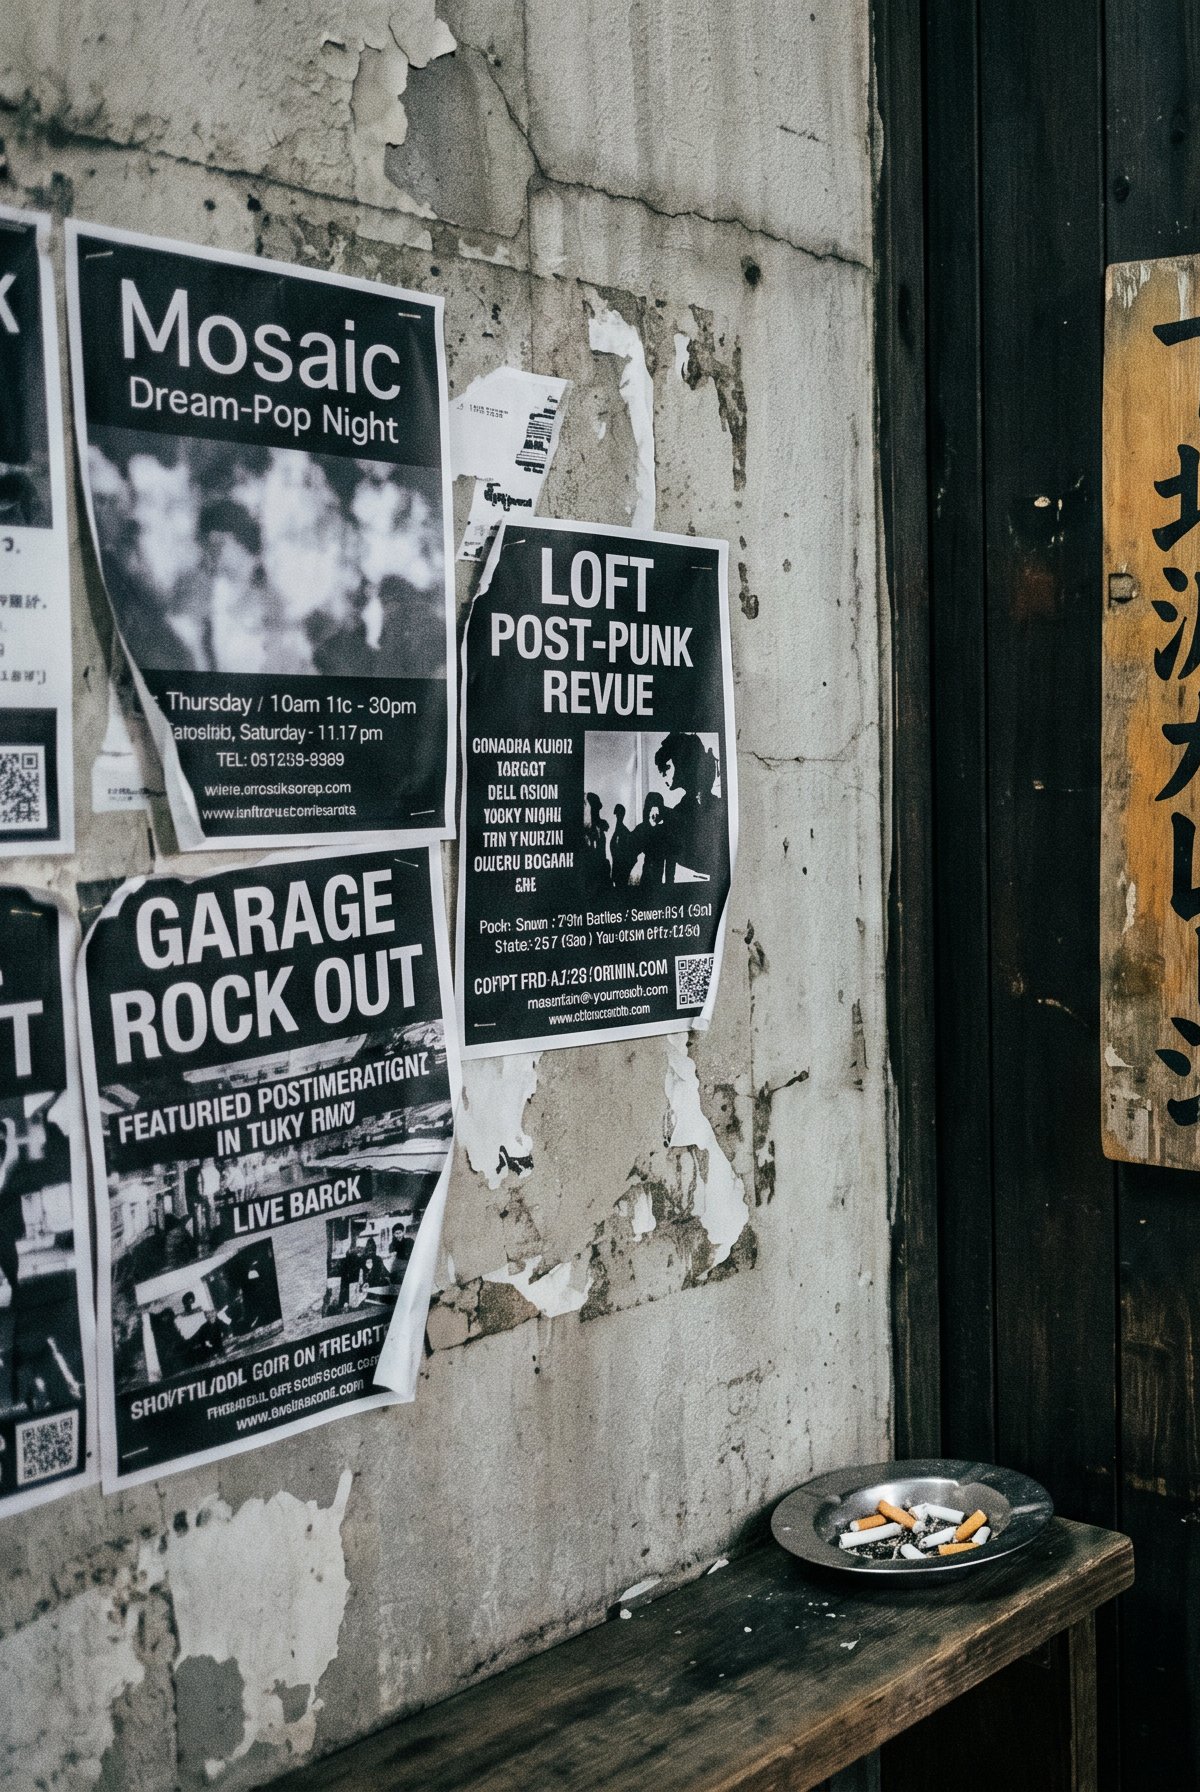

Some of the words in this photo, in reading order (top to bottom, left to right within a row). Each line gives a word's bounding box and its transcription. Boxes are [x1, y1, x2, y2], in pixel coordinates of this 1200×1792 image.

[120, 278, 401, 401] Mosaic
[130, 376, 312, 437] Dream-Pop
[323, 405, 399, 446] Night
[541, 547, 655, 613] LOFT
[491, 612, 694, 668] POST-PUNK
[166, 692, 252, 716] Thursday
[270, 694, 320, 713] 10am
[369, 697, 417, 717] 30pm
[543, 670, 654, 717] REVUE
[216, 752, 248, 767] TEL:
[488, 785, 517, 800] DELL
[136, 868, 396, 970] GARAGE
[110, 965, 300, 1066] ROCK
[313, 943, 423, 1024] OUT
[217, 1129, 241, 1157] IN
[246, 1115, 305, 1150] TUKY
[233, 1197, 284, 1234] LIVE
[289, 1175, 363, 1219] BARCK
[293, 1344, 316, 1368] ON
